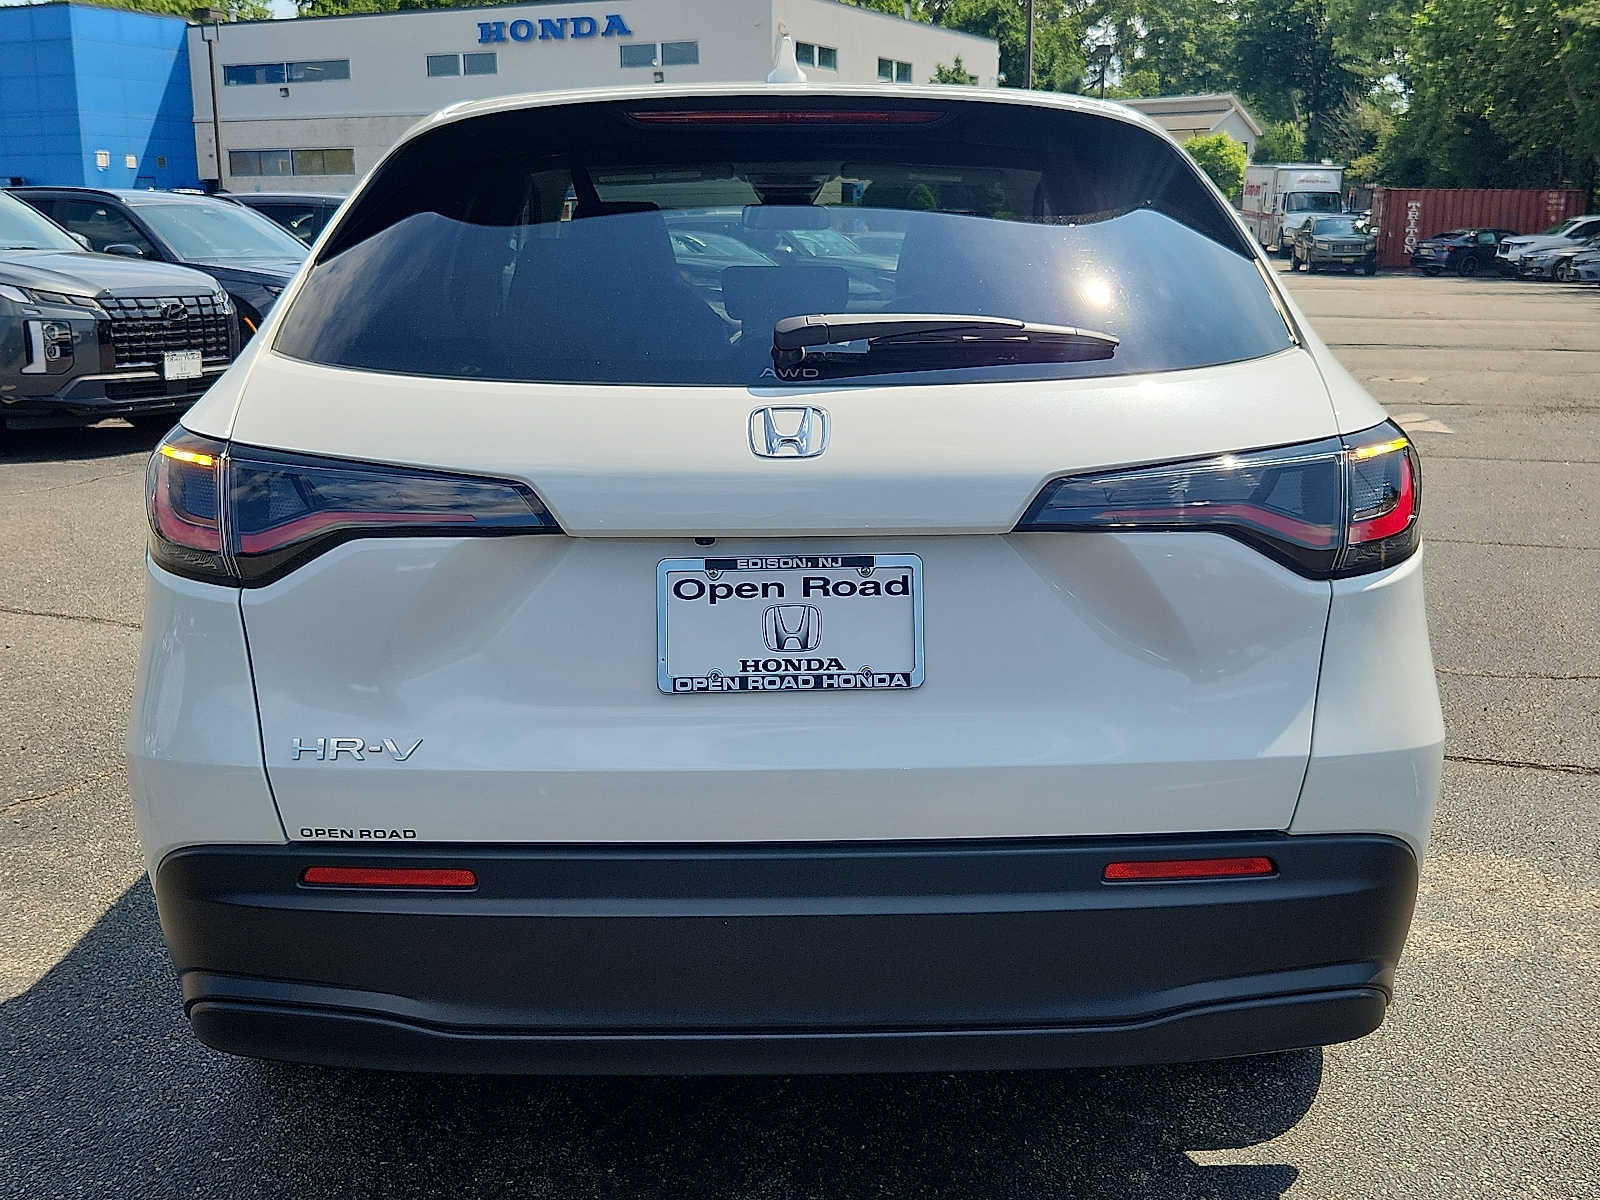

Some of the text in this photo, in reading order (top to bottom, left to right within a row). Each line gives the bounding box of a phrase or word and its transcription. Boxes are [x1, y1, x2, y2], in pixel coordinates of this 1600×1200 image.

[477, 14, 632, 44] HONDA
[1404, 202, 1420, 253] TRITON
[760, 367, 819, 378] AWD
[736, 557, 843, 570] EDISON, NJ
[672, 575, 910, 604] Open Road
[739, 657, 847, 673] HONDA
[675, 673, 908, 691] OPEN ROAD HONDA
[291, 737, 424, 762] HR-V
[300, 828, 417, 839] OPEN ROAD
